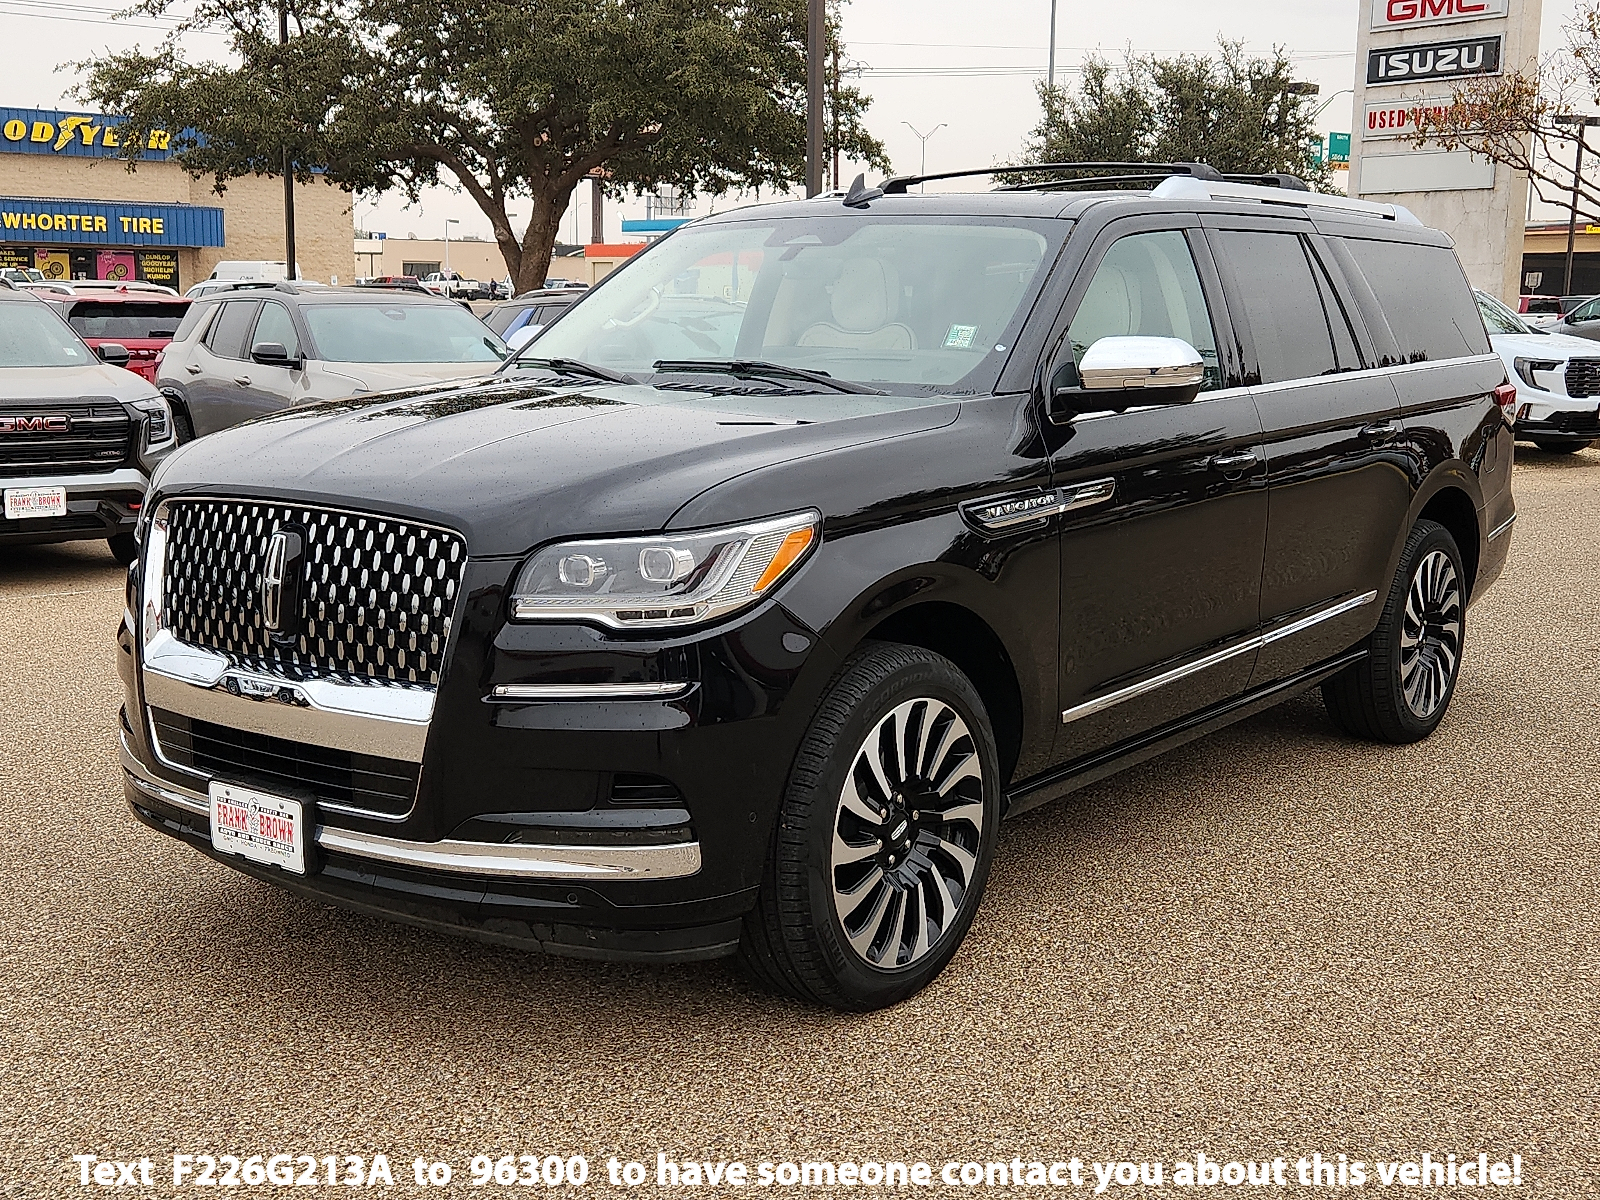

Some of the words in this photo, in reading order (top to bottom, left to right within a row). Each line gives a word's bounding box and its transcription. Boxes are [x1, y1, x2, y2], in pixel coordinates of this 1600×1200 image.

[1386, 0, 1485, 21] GMC
[1378, 45, 1484, 78] ISUZU
[1368, 109, 1406, 129] USED
[0, 212, 107, 232] WHORTER
[119, 216, 164, 235] TIRE
[0, 417, 67, 431] GMC
[10, 496, 31, 507] FRANK
[38, 494, 61, 506] BROWN
[985, 494, 1056, 518] NAVIGATOR
[216, 803, 249, 832] FRANK
[258, 814, 295, 845] BROWN
